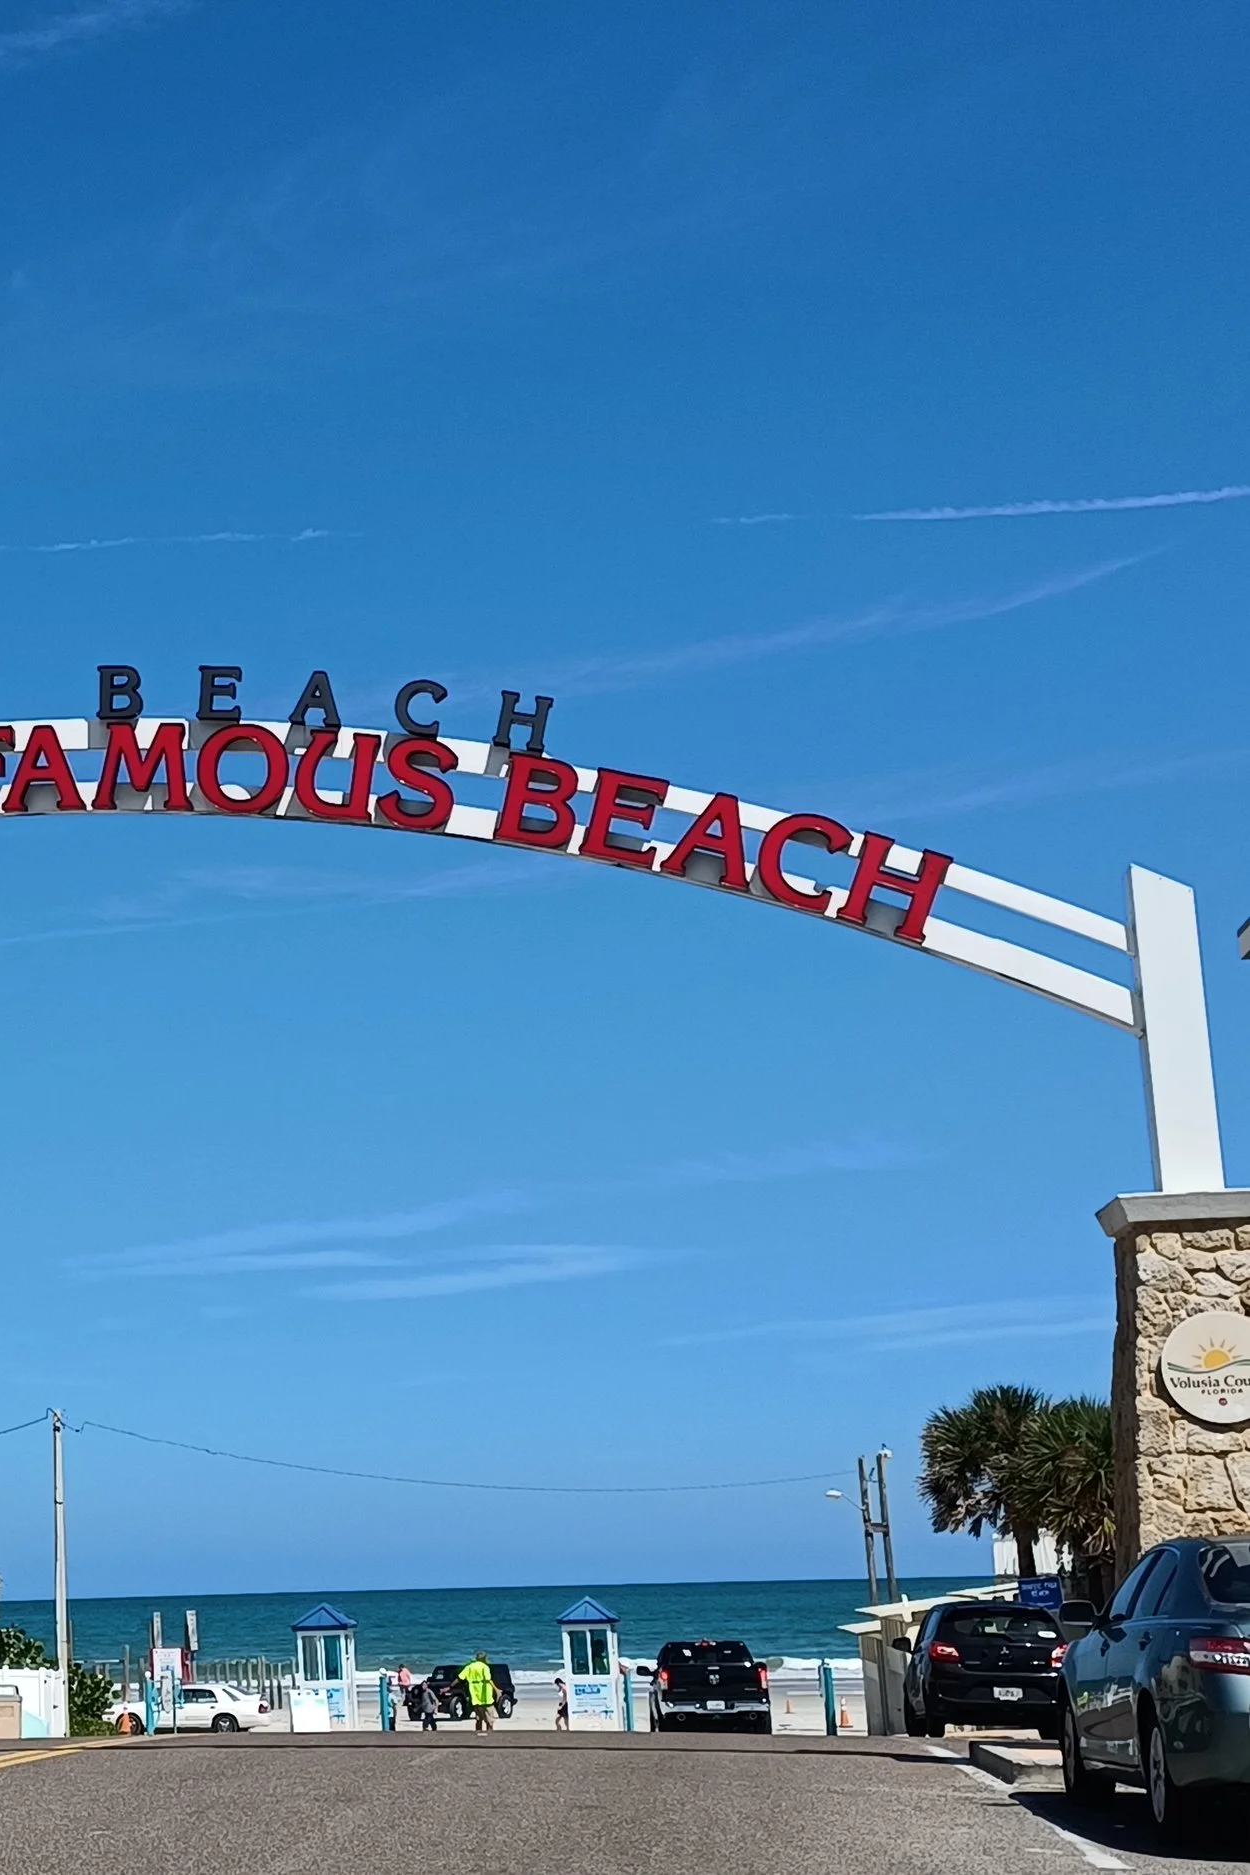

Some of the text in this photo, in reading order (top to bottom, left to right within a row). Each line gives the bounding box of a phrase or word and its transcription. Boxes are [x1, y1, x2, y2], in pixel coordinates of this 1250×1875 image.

[96, 665, 554, 754] BEACH
[494, 753, 953, 945] BEACH
[1170, 1376, 1220, 1388] Volusia
